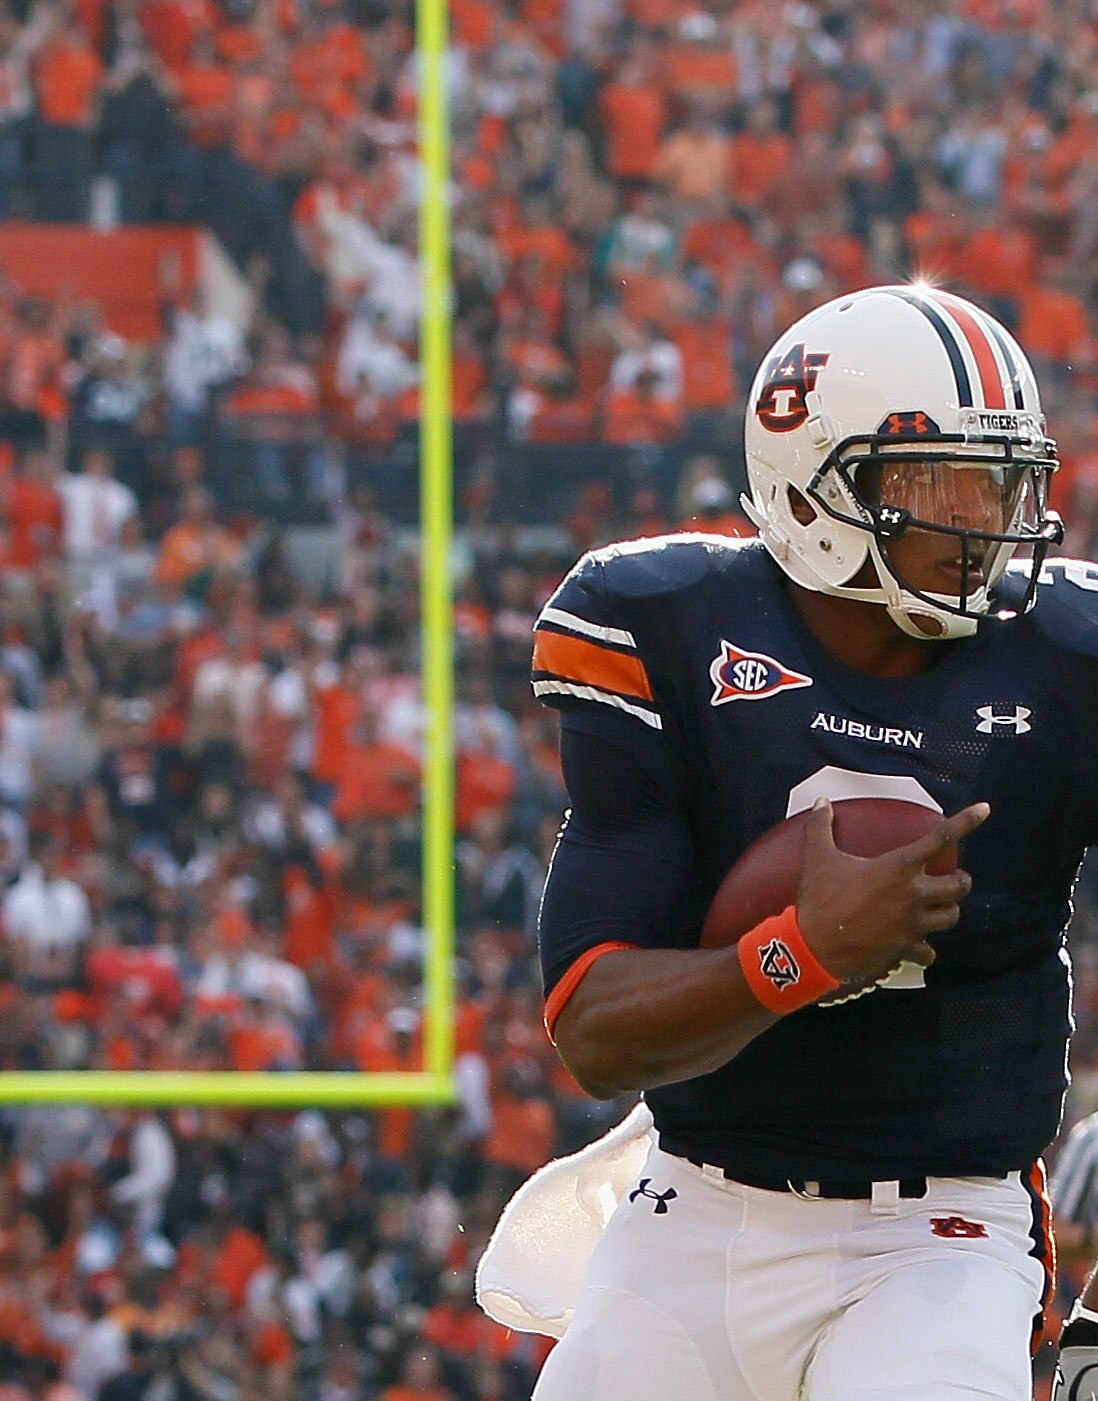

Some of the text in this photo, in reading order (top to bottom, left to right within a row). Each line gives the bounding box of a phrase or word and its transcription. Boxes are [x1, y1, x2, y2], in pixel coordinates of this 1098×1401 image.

[979, 414, 1018, 430] TIGERS
[732, 659, 768, 691] SEC
[810, 712, 923, 749] AUBURN
